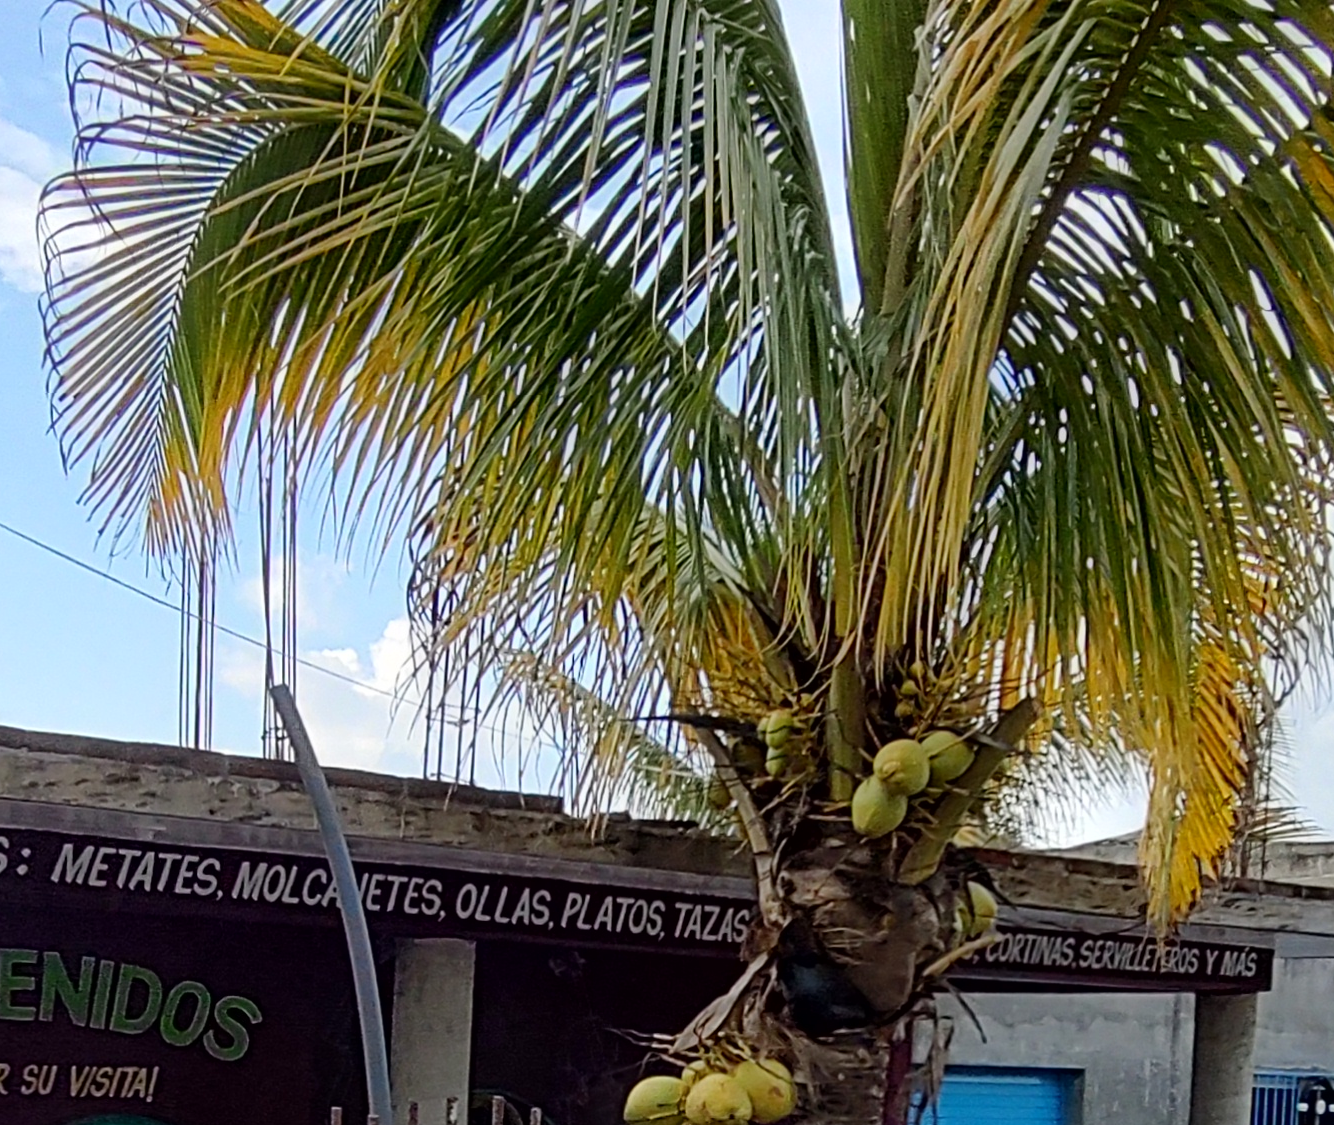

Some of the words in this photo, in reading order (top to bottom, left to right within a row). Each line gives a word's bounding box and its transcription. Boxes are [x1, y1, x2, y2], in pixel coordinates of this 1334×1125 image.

[51, 843, 224, 900] METATES,
[455, 883, 554, 930] OLLAS,
[560, 892, 665, 940] PLATOS,
[1206, 948, 1219, 976] Y
[1219, 946, 1258, 978] MÁS
[20, 1064, 58, 1095] SU
[70, 1065, 159, 1102] VISITA!
